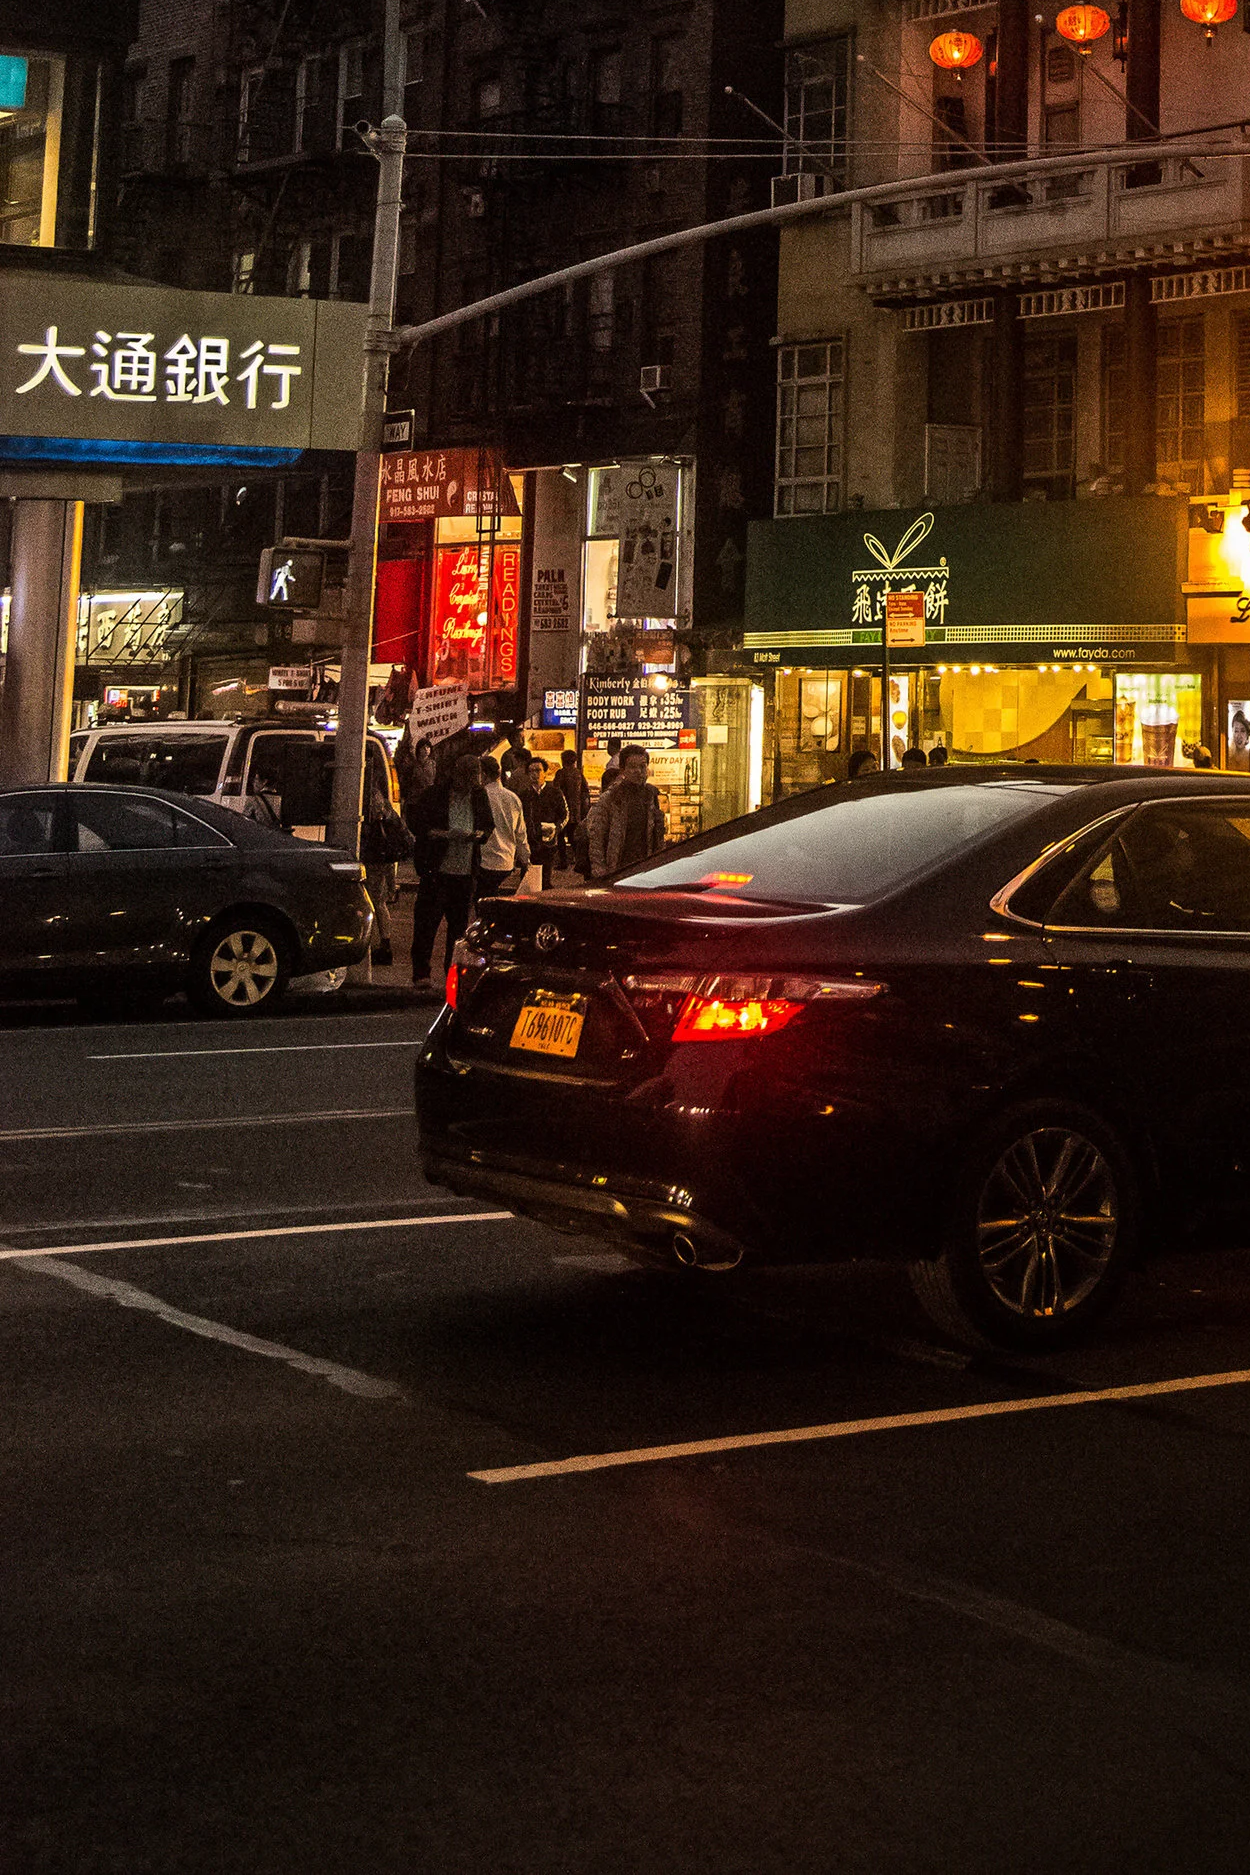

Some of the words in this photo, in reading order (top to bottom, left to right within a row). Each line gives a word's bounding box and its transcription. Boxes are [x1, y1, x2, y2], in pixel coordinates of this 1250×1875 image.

[16, 325, 301, 409] 大通銀行
[386, 488, 412, 503] FENG
[417, 486, 439, 501] SHUI
[500, 553, 515, 672] READINGS
[1053, 647, 1136, 661] www.fayda.com
[589, 678, 630, 693] Kimberly
[588, 696, 609, 706] BODY
[611, 696, 634, 706] WORK
[587, 709, 608, 719] FOOT
[610, 709, 626, 719] RUB
[521, 1010, 577, 1044] T696107C
